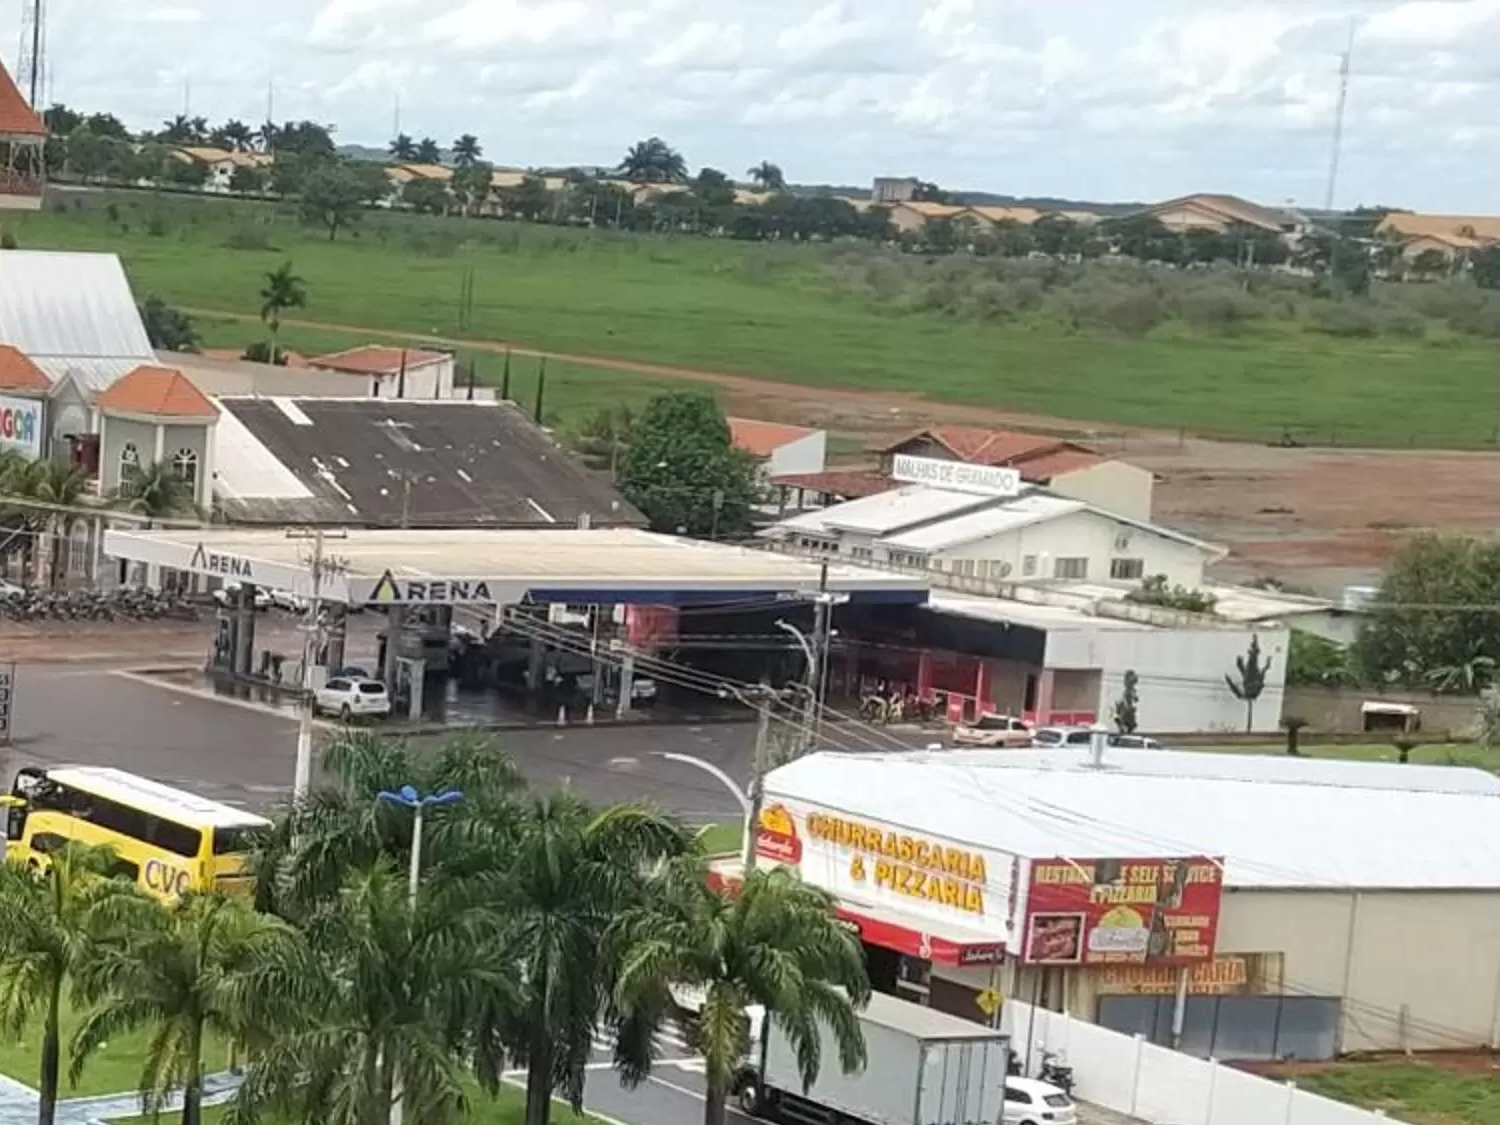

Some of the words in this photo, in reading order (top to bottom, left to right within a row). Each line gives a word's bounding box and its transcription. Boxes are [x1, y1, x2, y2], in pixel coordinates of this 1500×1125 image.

[192, 541, 253, 577] ARENA
[369, 569, 492, 602] ARENA
[806, 811, 986, 883] CHURRASCARIA
[874, 859, 985, 915] PIZZARIA
